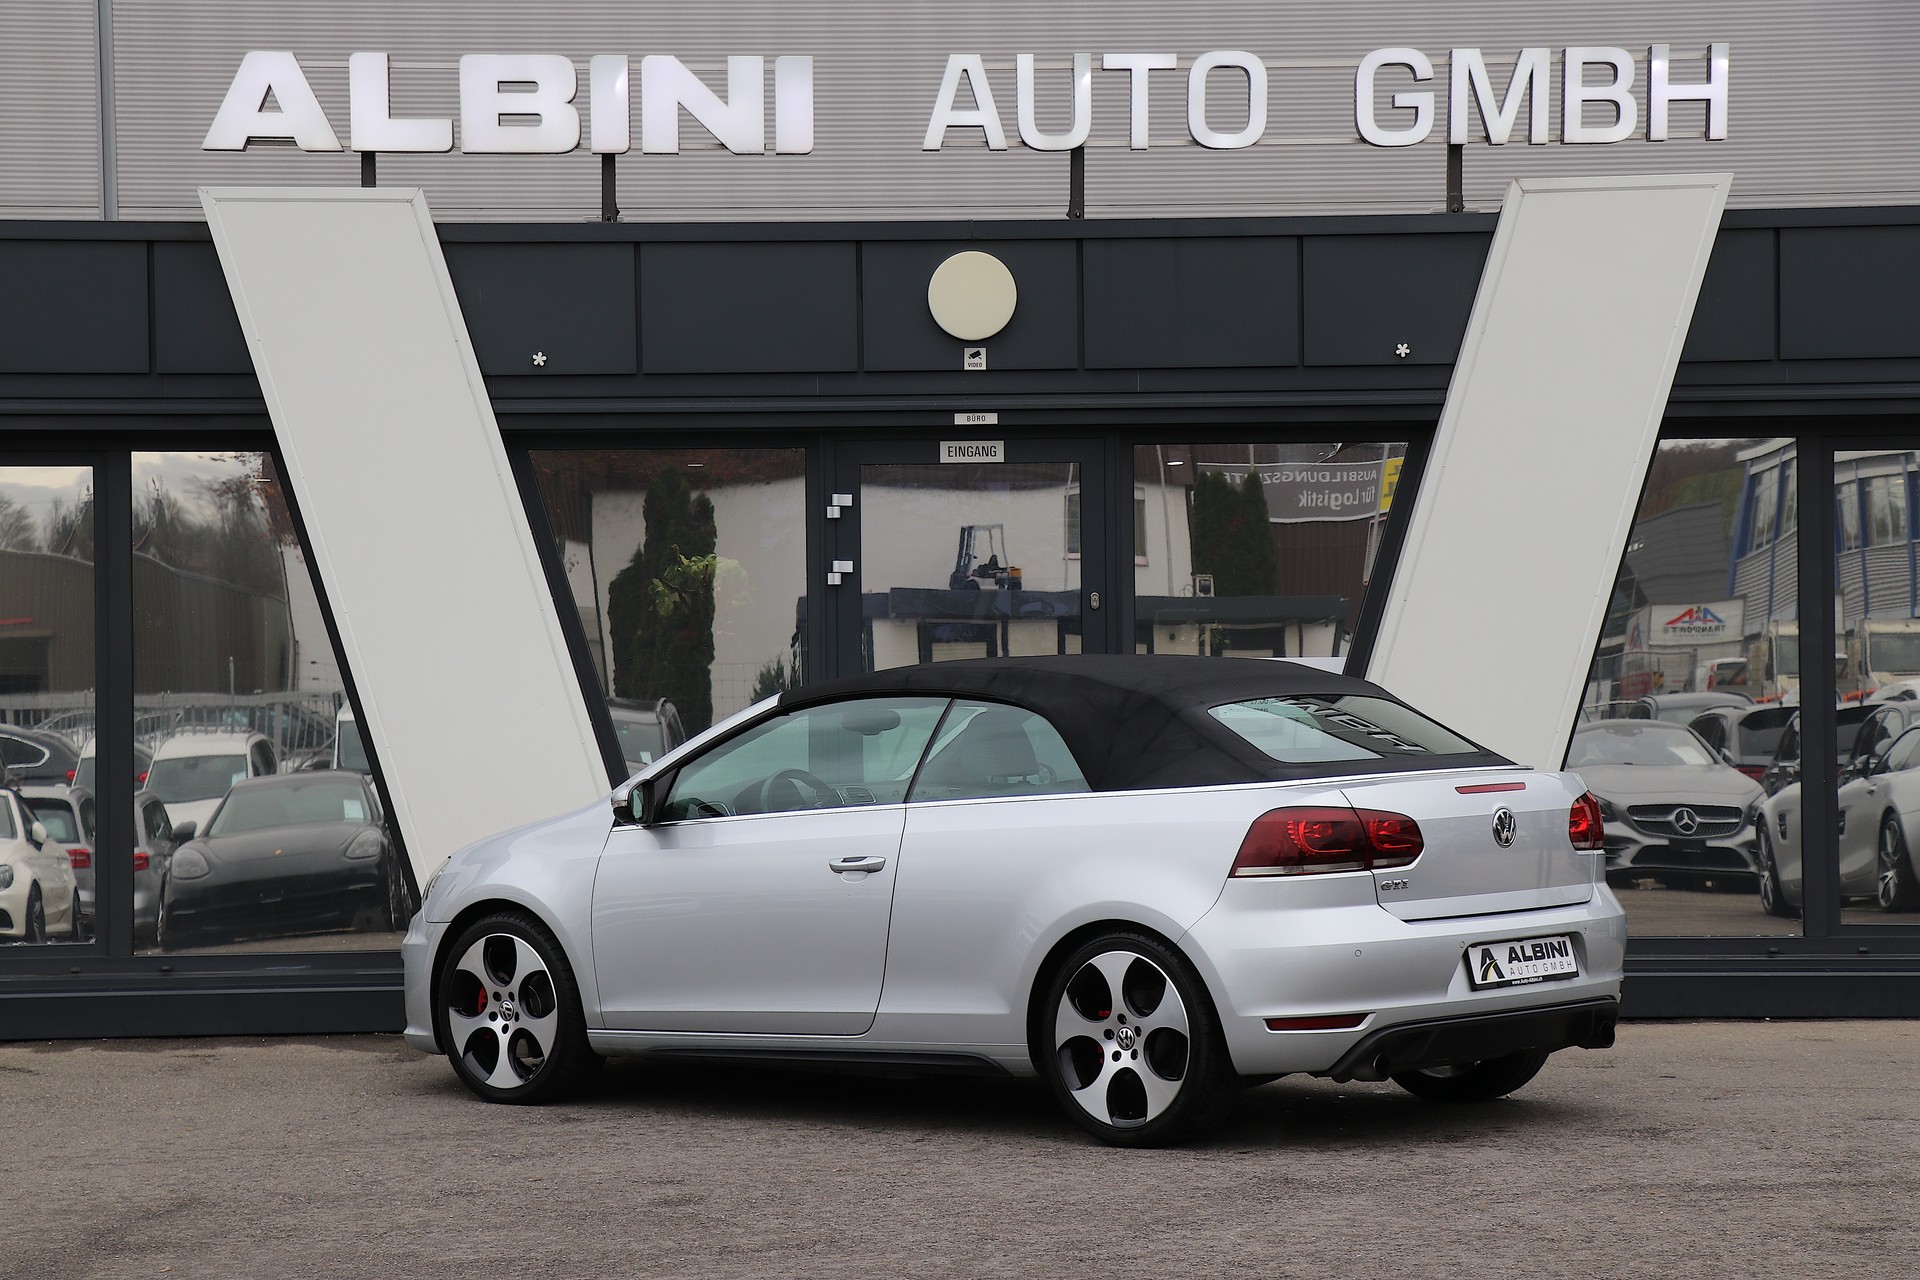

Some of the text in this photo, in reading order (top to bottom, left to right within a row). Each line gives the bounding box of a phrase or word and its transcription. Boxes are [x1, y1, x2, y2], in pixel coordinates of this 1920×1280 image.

[202, 43, 1729, 155] ALBINI AUTO GMBH
[966, 413, 986, 422] BÜRO
[947, 445, 997, 457] EINGANG
[1508, 940, 1569, 965] ALBINI
[1510, 960, 1573, 976] AUTO GMBH
